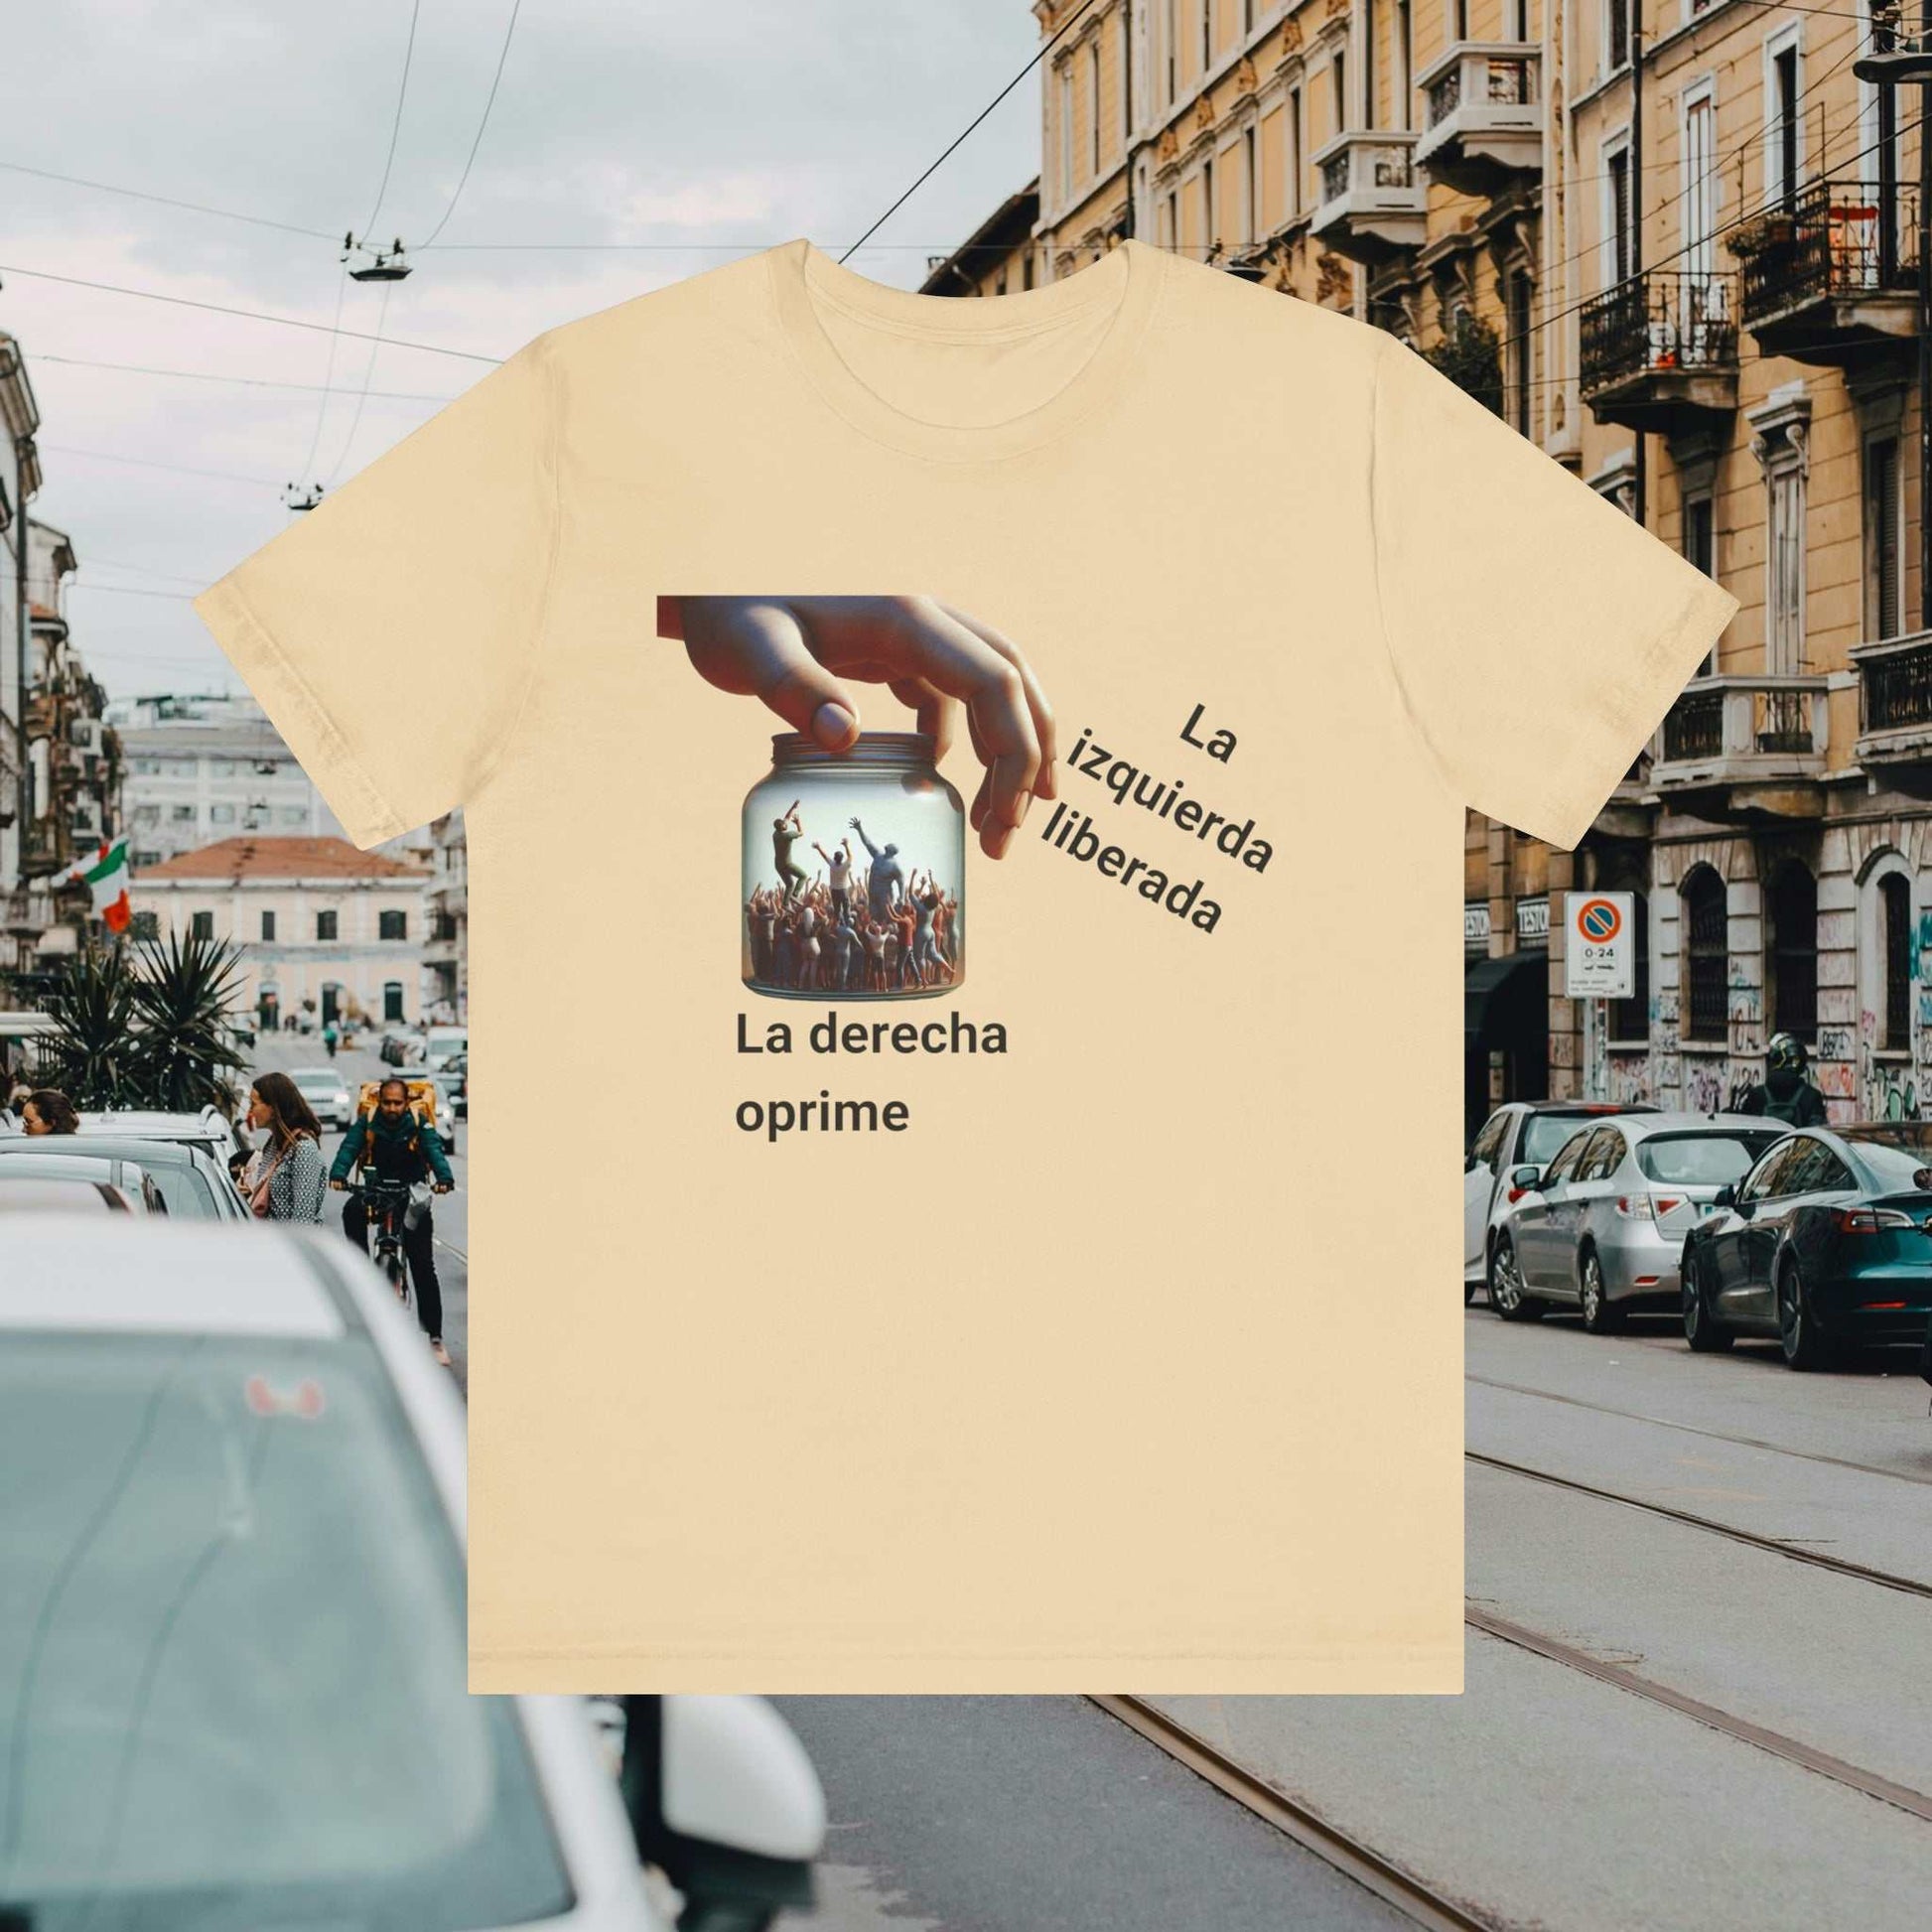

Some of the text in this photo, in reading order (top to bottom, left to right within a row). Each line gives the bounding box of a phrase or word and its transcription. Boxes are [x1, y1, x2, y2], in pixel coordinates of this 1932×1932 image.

[1179, 703, 1237, 763] La
[1066, 728, 1273, 874] izquierda
[1040, 801, 1222, 934] liberada
[738, 1011, 1008, 1054] La derecha
[736, 1089, 909, 1143] oprime
